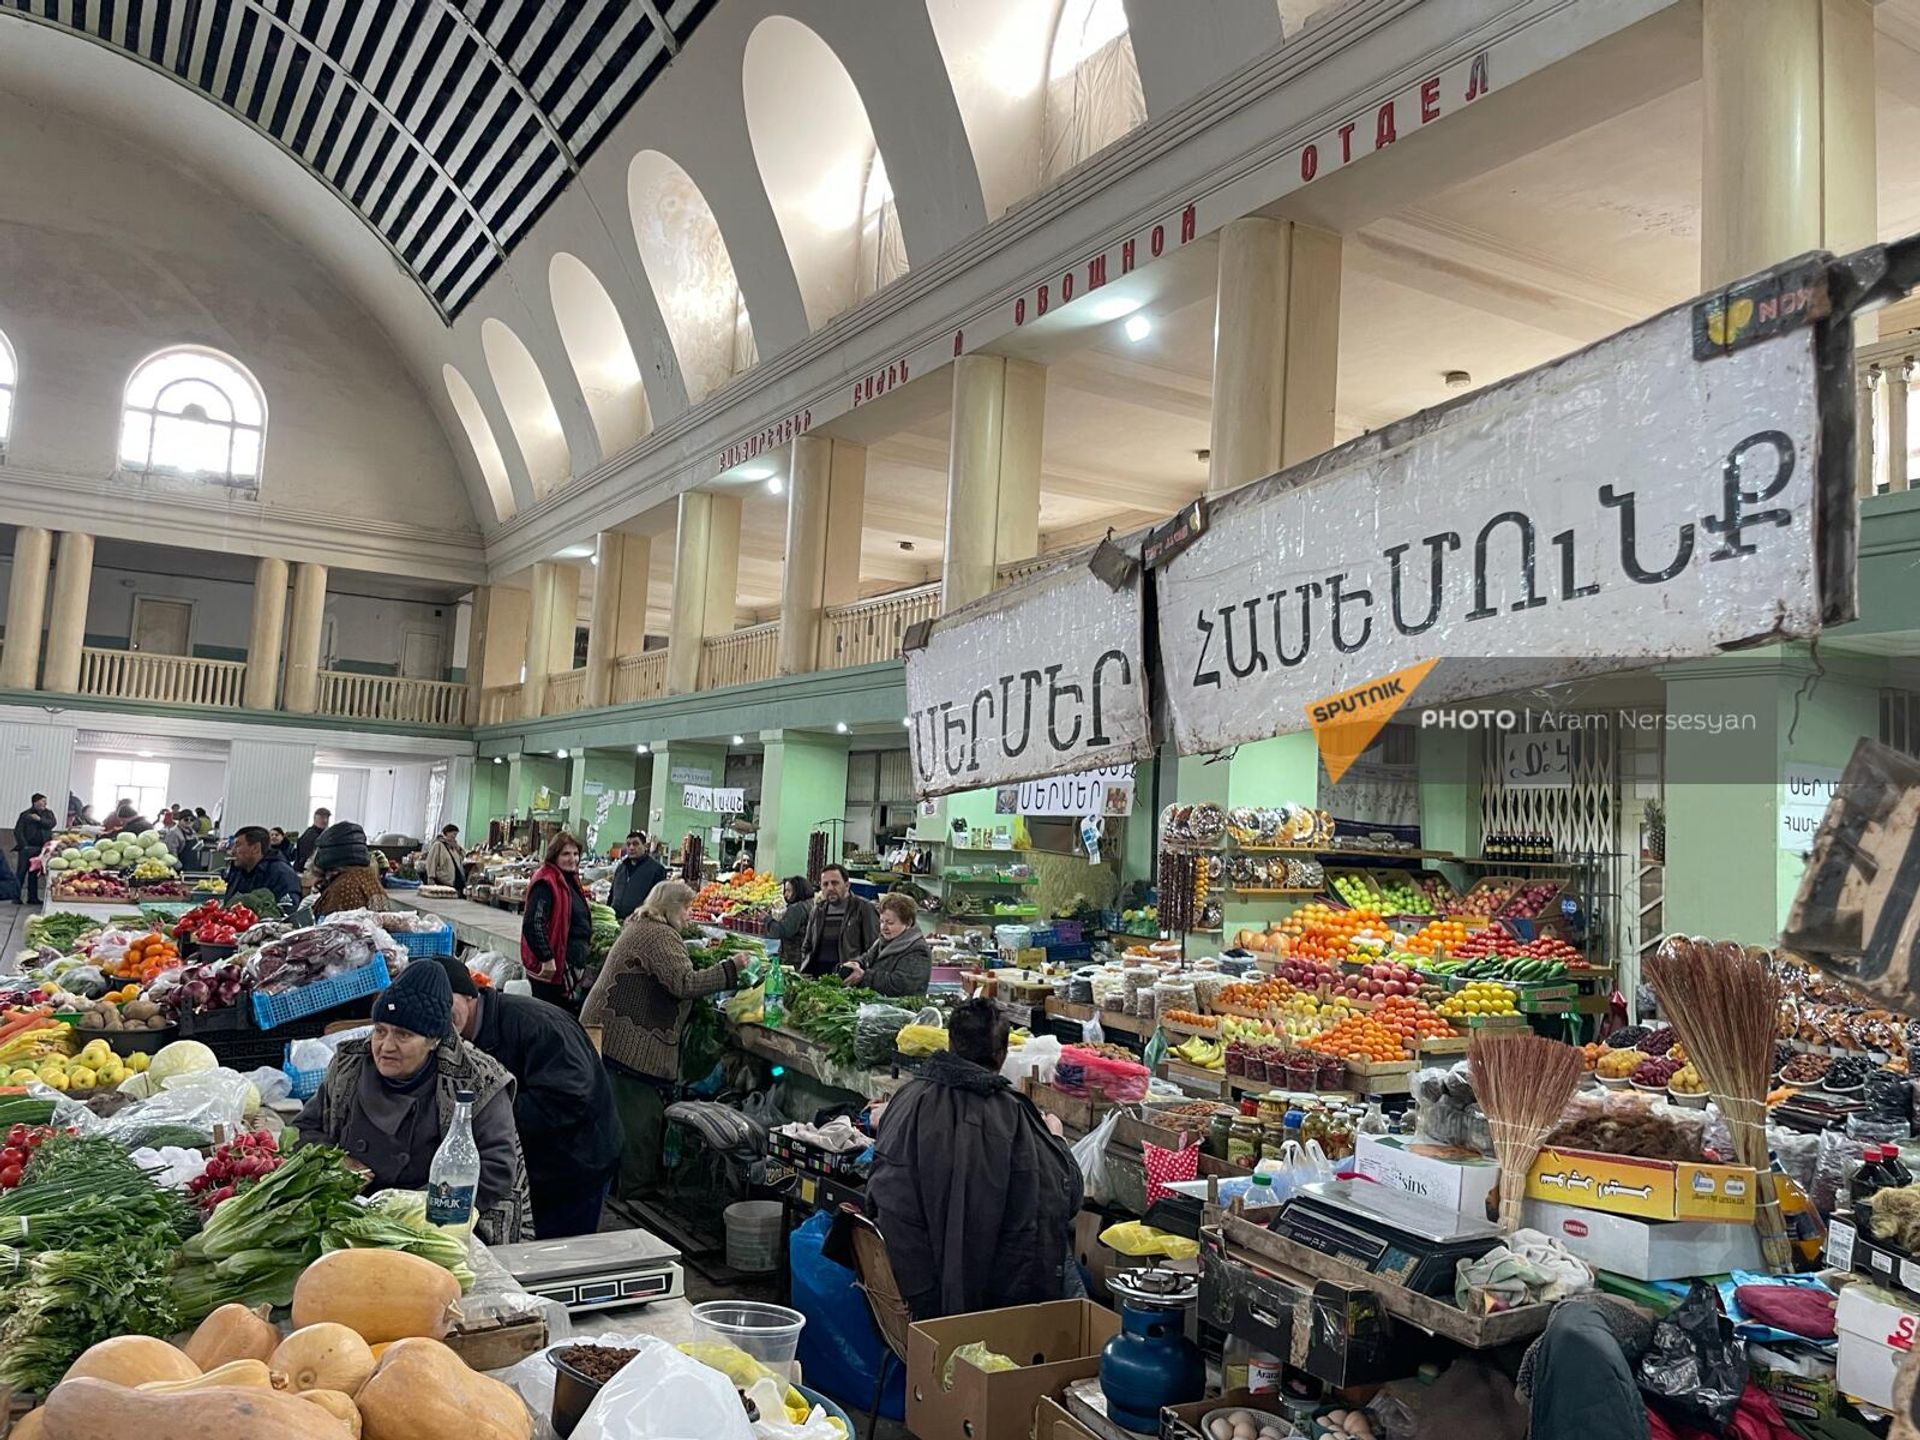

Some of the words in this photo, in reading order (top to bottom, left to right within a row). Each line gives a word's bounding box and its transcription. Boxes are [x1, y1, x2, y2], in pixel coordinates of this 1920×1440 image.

[1015, 203, 1196, 326] ОВОЩНОЙ
[1301, 51, 1488, 182] ОТДЕЛ
[854, 359, 909, 407] ԲԱԺԻՆ
[911, 649, 1132, 782] ՍԵՐՄԵՐ
[1021, 780, 1101, 811] ՍԵՐՄԵՐ
